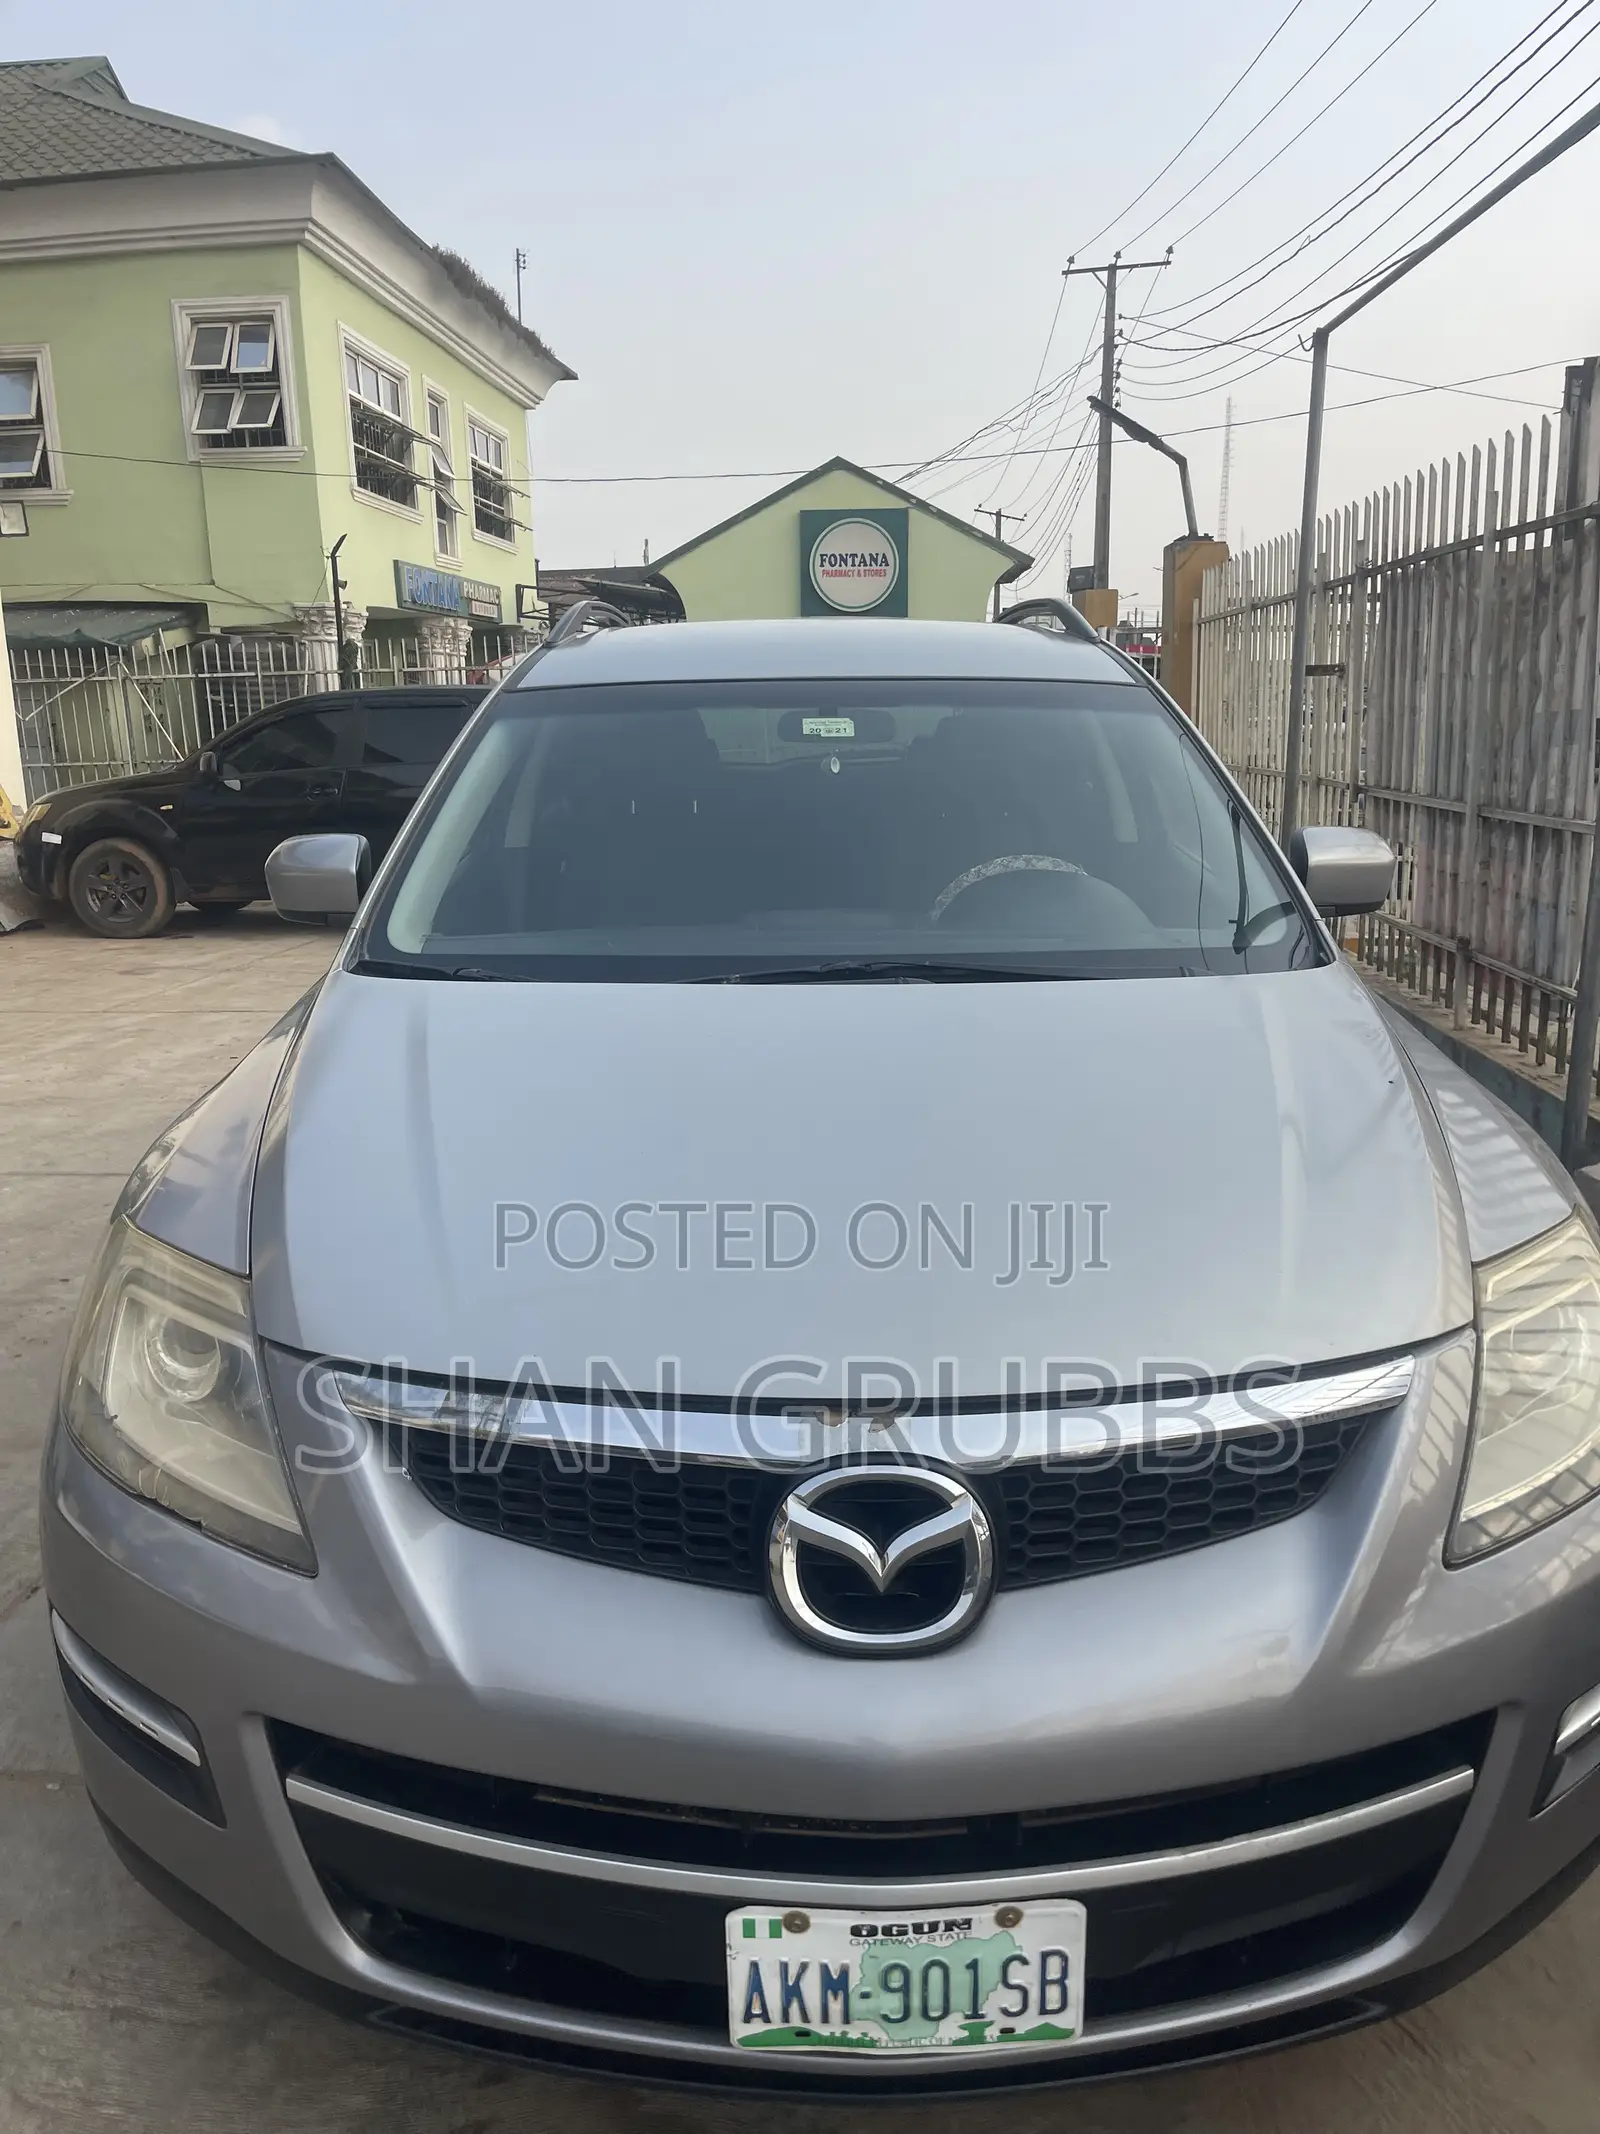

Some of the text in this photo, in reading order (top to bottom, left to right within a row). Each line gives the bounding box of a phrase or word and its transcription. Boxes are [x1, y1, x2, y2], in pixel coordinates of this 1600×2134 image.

[819, 553, 890, 567] FONTANA
[822, 569, 855, 578] PHARMACY
[863, 569, 887, 578] STORES
[403, 565, 461, 612] FONTANA
[850, 1917, 973, 1938] OGUN
[849, 1931, 972, 1948] GATEWAY STATE
